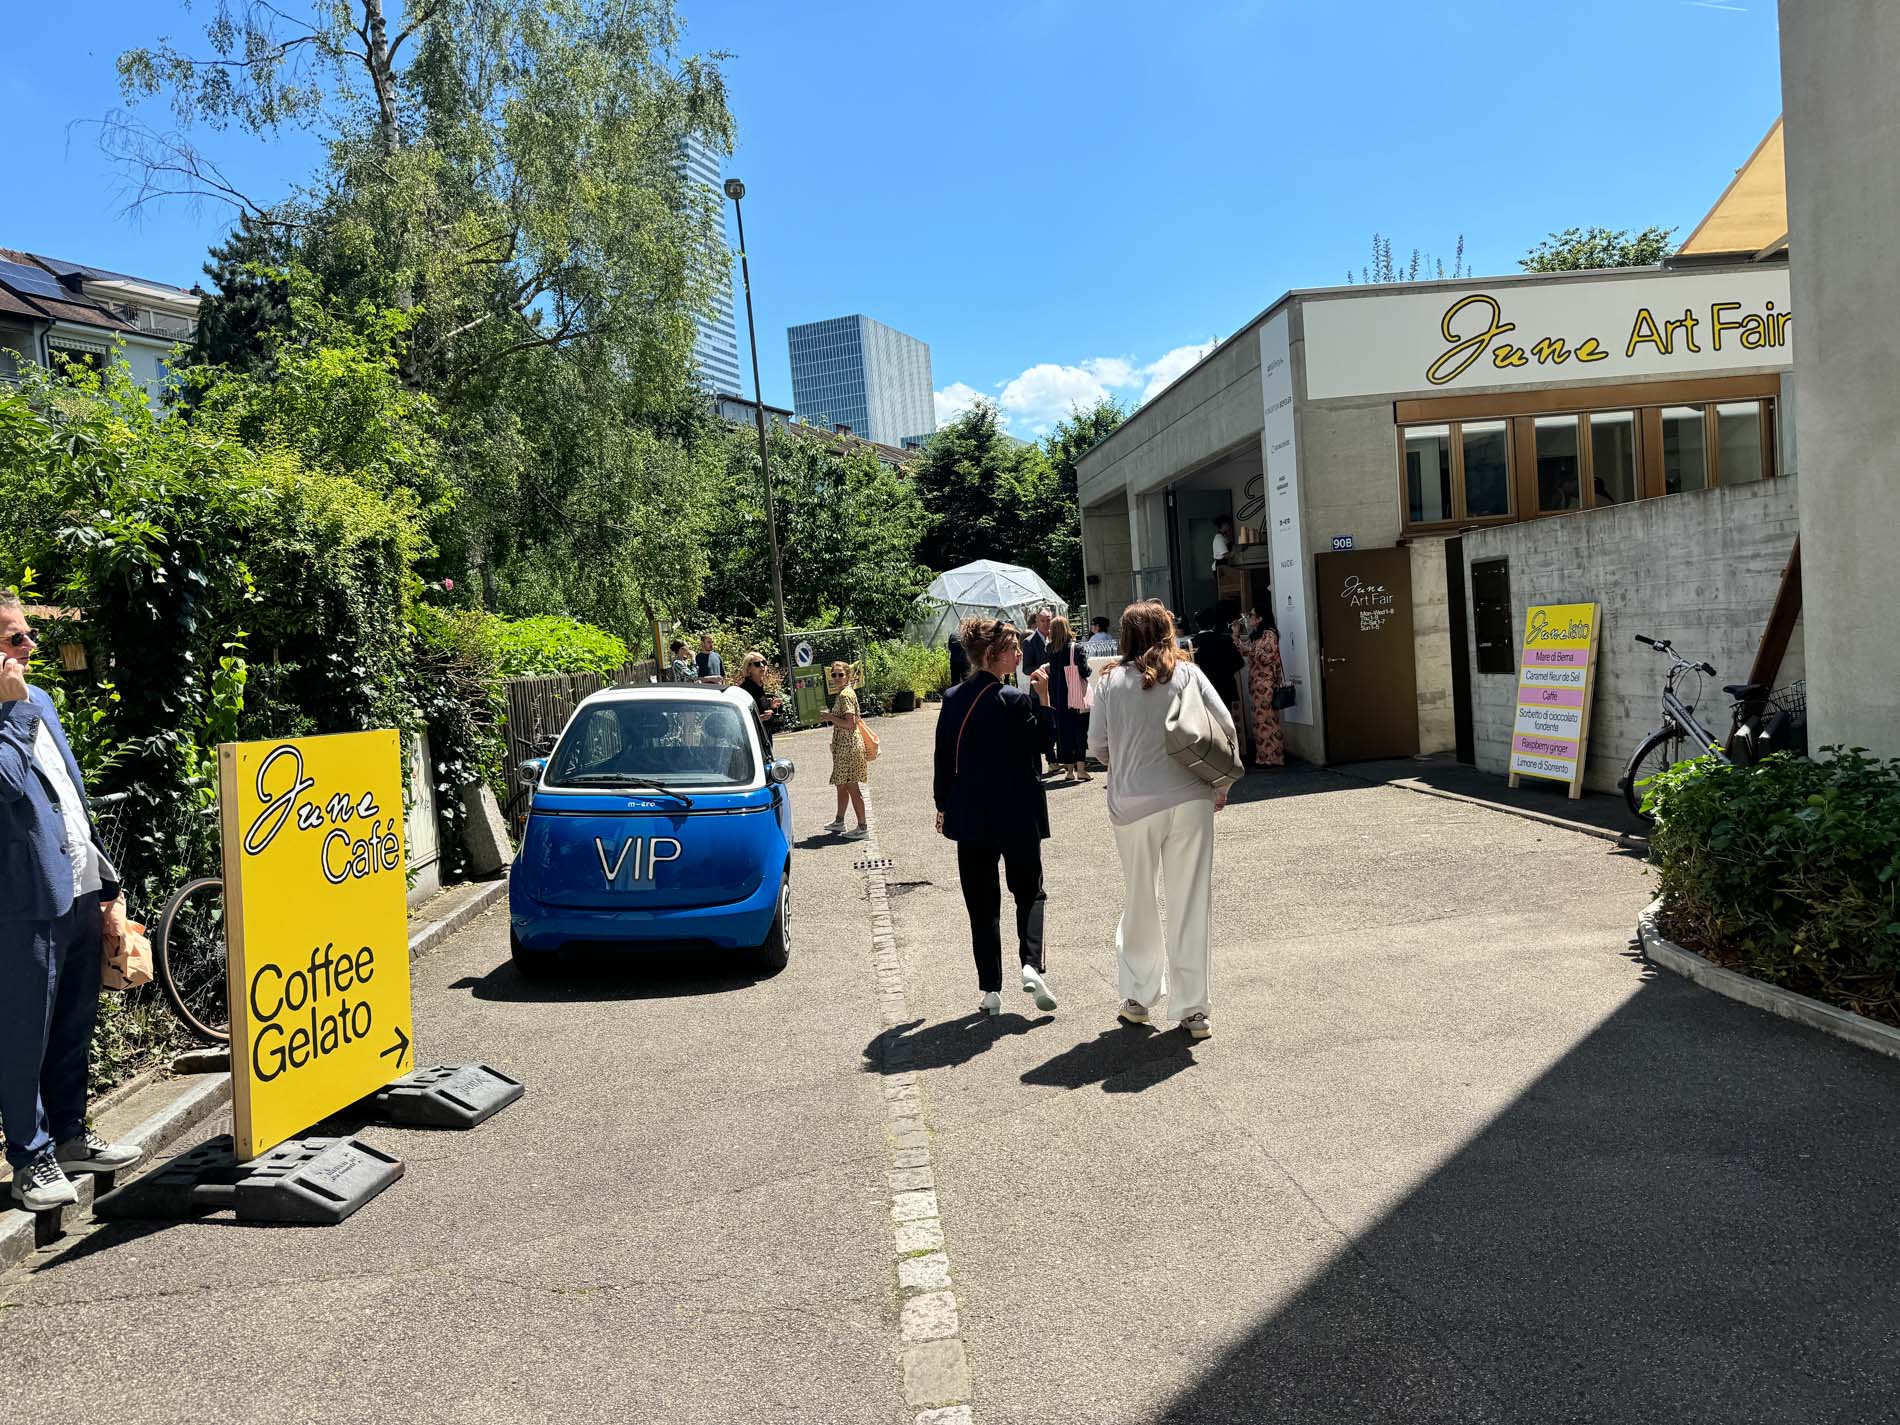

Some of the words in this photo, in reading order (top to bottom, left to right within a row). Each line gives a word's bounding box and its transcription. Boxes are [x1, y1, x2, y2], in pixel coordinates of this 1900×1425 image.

[1426, 294, 1609, 385] June
[1626, 309, 1701, 358] Art
[1710, 301, 1792, 351] Fair
[1333, 538, 1352, 549] 90B
[1341, 575, 1385, 598] June
[1350, 594, 1370, 607] Art
[1371, 592, 1393, 605] Fair
[1535, 651, 1550, 661] Mare
[1551, 651, 1557, 661] di
[1525, 670, 1549, 681] Caramel
[1562, 671, 1570, 682] de
[1570, 671, 1580, 682] Sel
[1519, 707, 1543, 720] Sorbetto
[1543, 710, 1549, 720] di
[1549, 711, 1578, 723] cioccolato
[1534, 720, 1560, 732] fondente
[1521, 738, 1550, 752] Raspberry
[1550, 742, 1569, 755] ginger
[1517, 756, 1538, 769] Limone
[1538, 759, 1544, 770] di
[1544, 760, 1569, 774] Sorrento
[244, 744, 380, 856] June
[321, 818, 400, 884] Café
[594, 836, 682, 880] VIP
[250, 943, 375, 1024] Coffee
[252, 999, 372, 1082] Gelato
